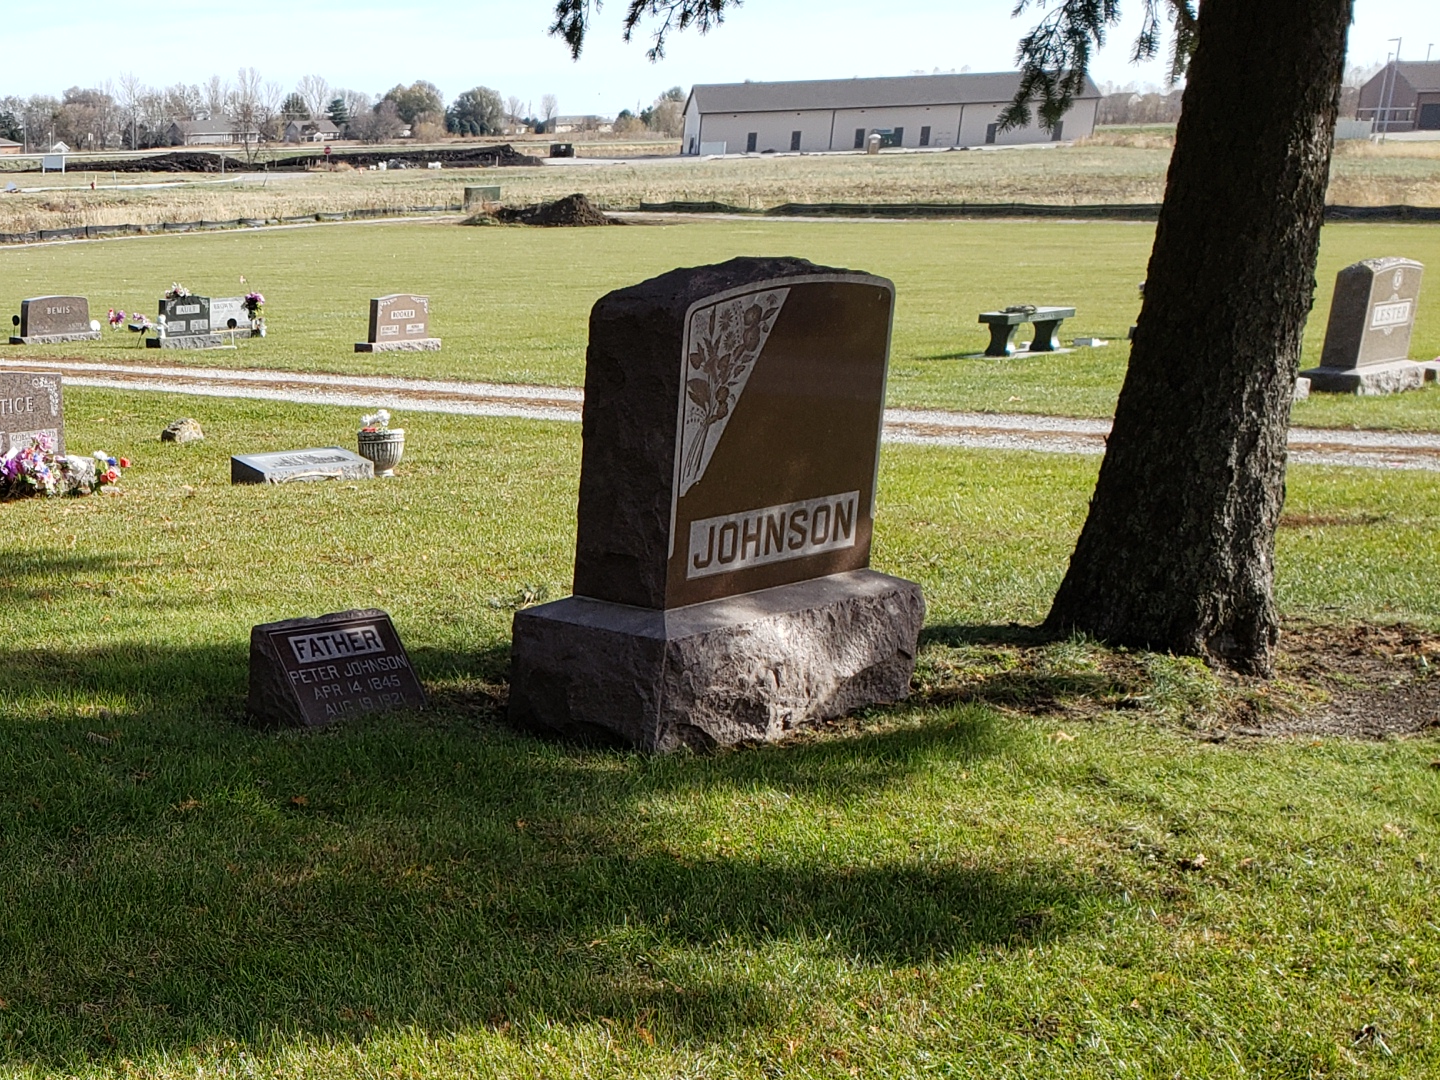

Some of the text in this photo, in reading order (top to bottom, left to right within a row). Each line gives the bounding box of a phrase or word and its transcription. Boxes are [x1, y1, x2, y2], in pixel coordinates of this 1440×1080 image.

[46, 306, 71, 315] BEMIS
[1374, 305, 1408, 322] LESTER
[692, 500, 856, 570] JOHNSON
[293, 629, 381, 660] FATHER
[288, 654, 409, 686] PETER JOHNSON
[368, 674, 401, 691] 1845
